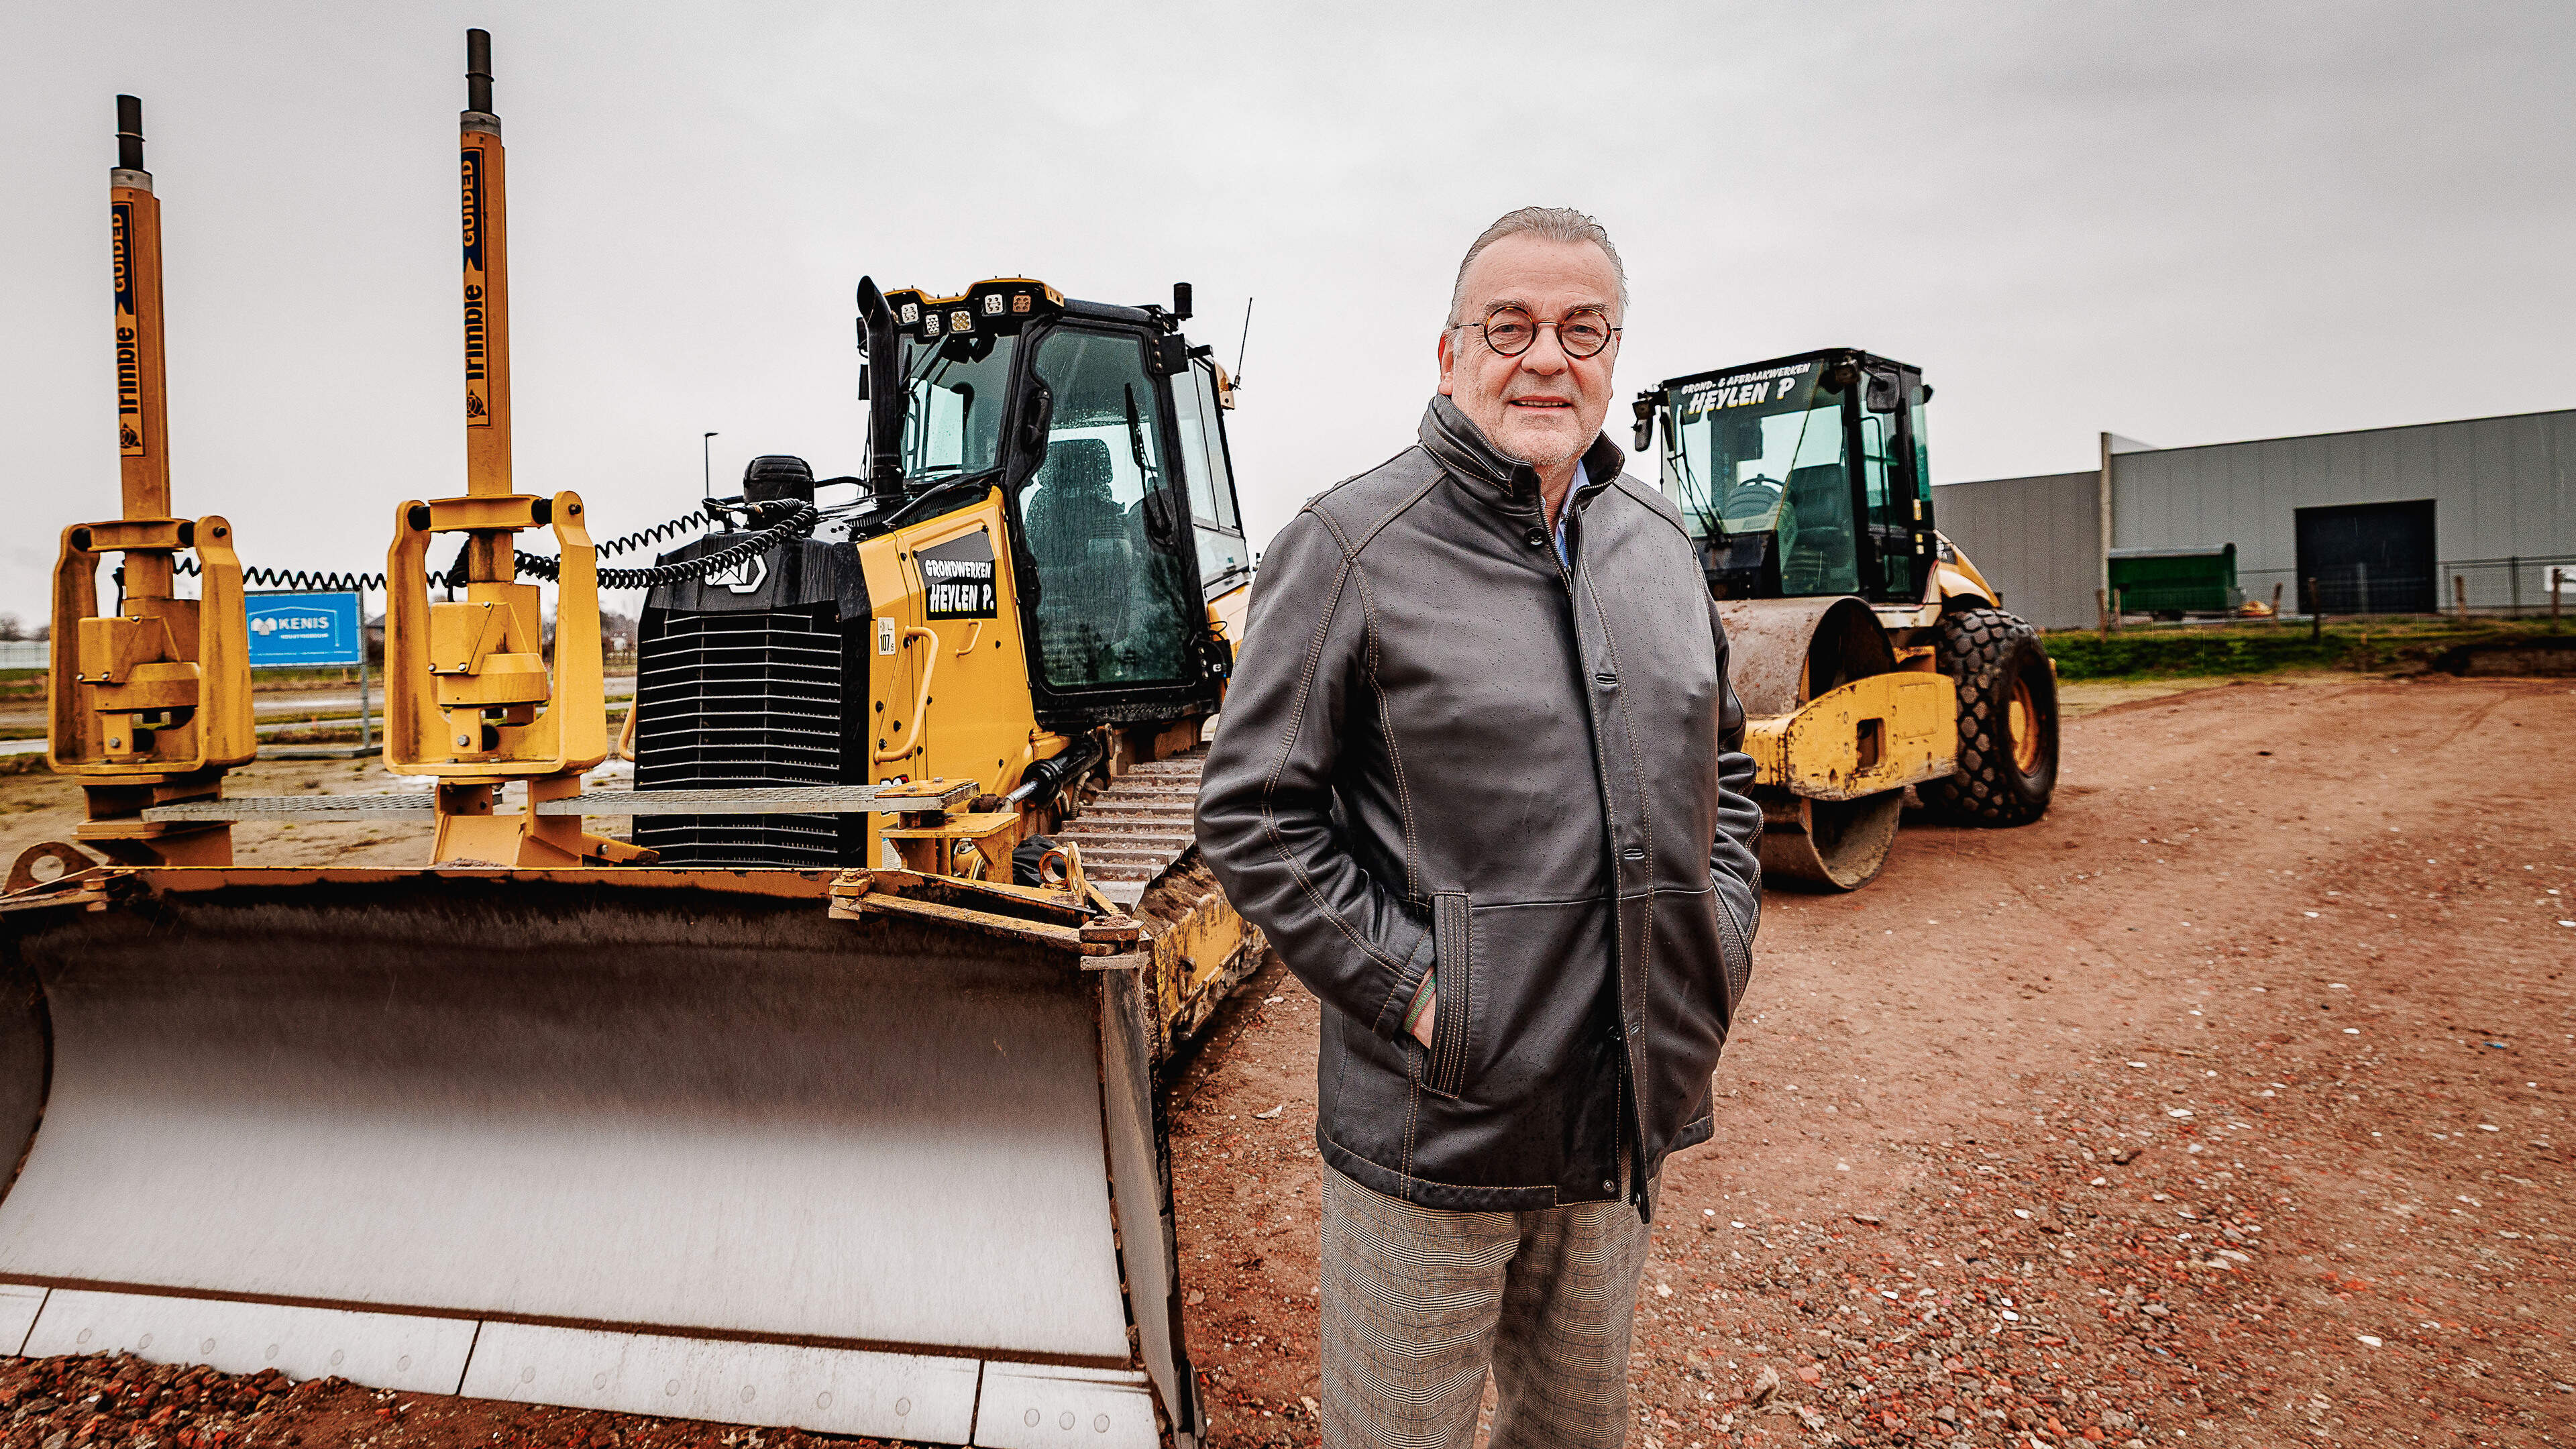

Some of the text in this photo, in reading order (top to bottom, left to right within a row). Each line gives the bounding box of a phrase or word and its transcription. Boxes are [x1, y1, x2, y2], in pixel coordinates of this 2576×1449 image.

[462, 160, 475, 247] GUIDED
[113, 213, 125, 292] GUIDED
[1681, 362, 1811, 395] GROND- & AFBRAAKWERKEN
[1688, 377, 1796, 415] HEYLEN P
[924, 559, 991, 579] GRONDWERKEN
[930, 584, 994, 612] HEYLEN P.
[278, 616, 329, 630] KENIS
[879, 634, 890, 651] 107
